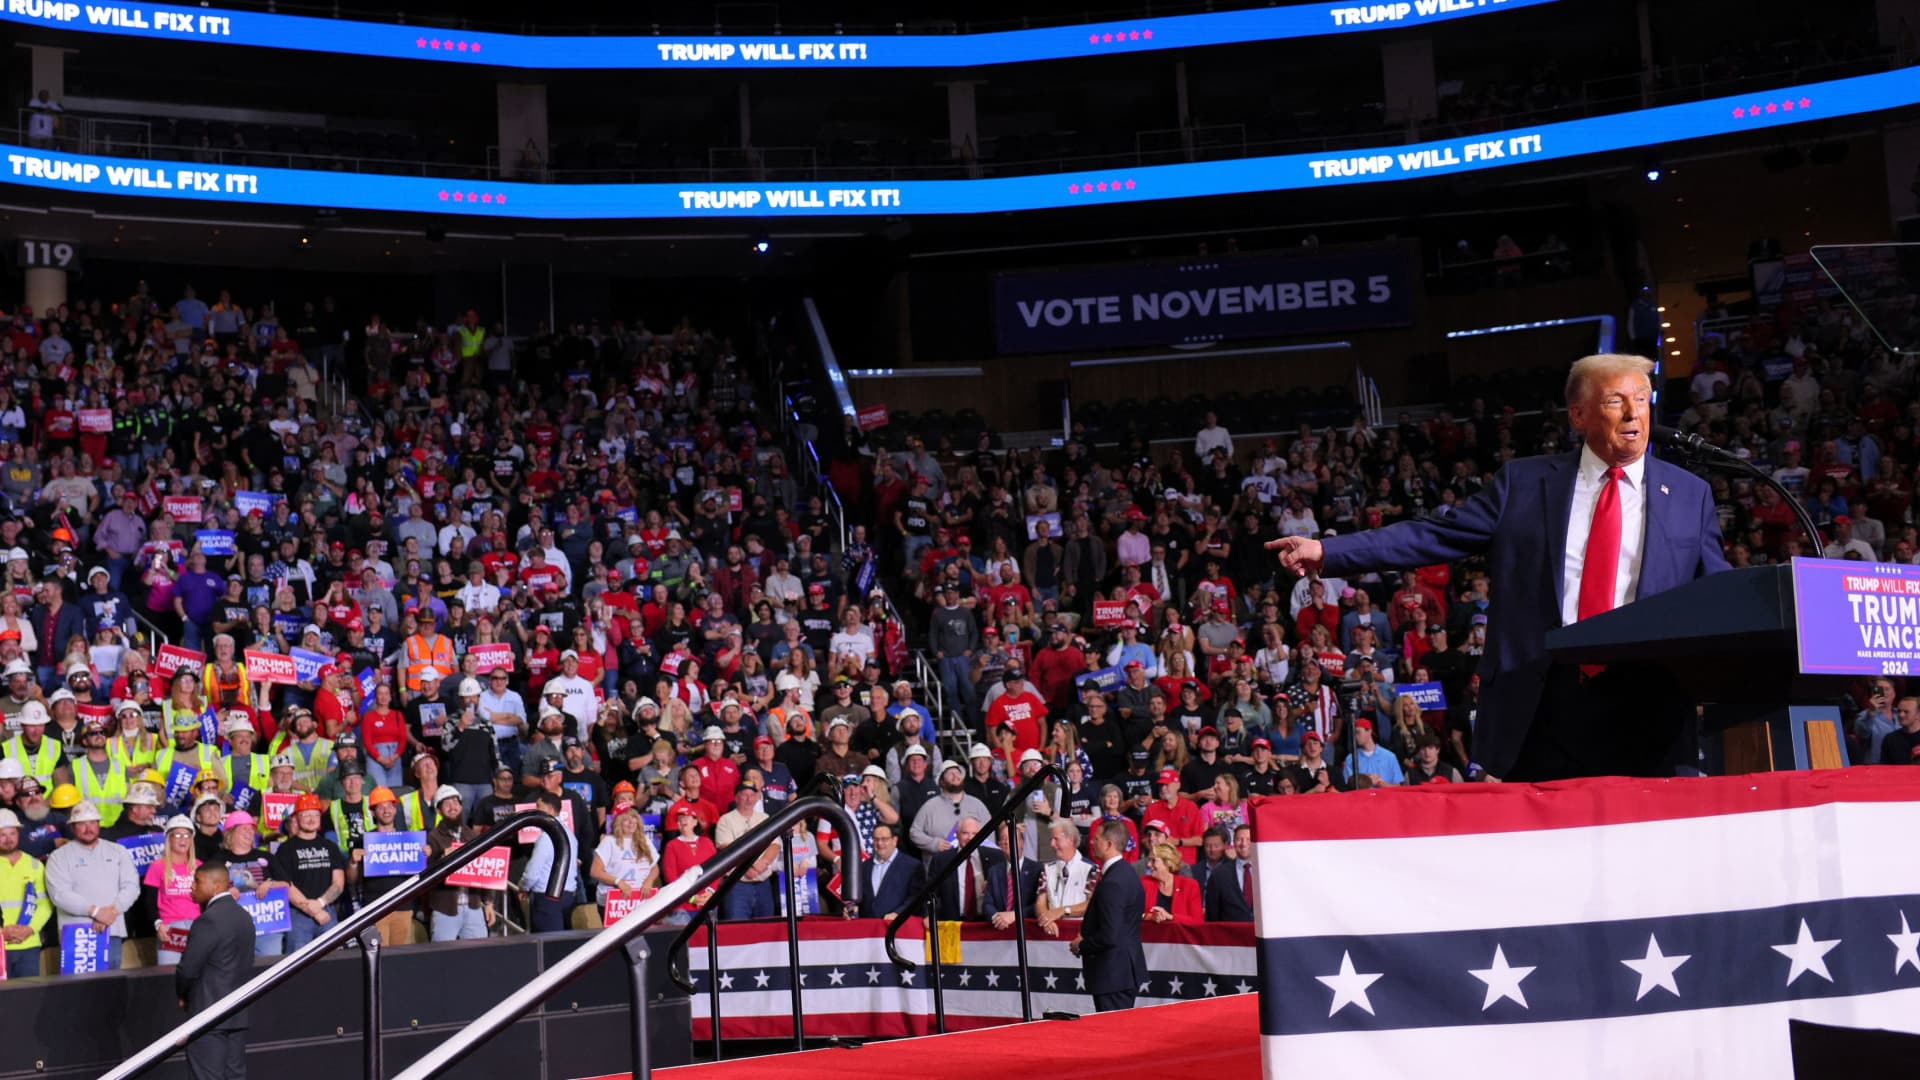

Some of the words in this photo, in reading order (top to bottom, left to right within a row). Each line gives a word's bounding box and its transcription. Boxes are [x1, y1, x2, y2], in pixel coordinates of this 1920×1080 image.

[0, 0, 81, 21] RUMP
[86, 5, 149, 29] WILL
[154, 12, 194, 33] FIX
[200, 16, 230, 36] IT!
[1331, 2, 1411, 25] TRUMP
[658, 43, 736, 61] TRUMP
[740, 43, 796, 61] WILL
[798, 43, 835, 60] FIX
[839, 43, 867, 60] IT!
[1309, 155, 1394, 179] TRUMP
[1397, 147, 1460, 171] WILL
[1464, 140, 1505, 162] FIX
[1510, 134, 1542, 156] IT!
[9, 155, 101, 184] TRUMP
[105, 166, 173, 190] WILL
[178, 171, 220, 192] FIX
[226, 174, 258, 194] IT!
[679, 190, 761, 209] TRUMP
[766, 190, 824, 208] WILL
[828, 190, 867, 208] FIX
[870, 189, 900, 208] IT!
[25, 242, 73, 267] 119
[1017, 296, 1121, 328] VOTE
[1132, 279, 1357, 321] NOVEMBER
[1368, 276, 1391, 304] 5
[1847, 577, 1880, 591] TRUMP
[1880, 579, 1905, 593] WILL
[1096, 608, 1124, 616] TRUM
[1848, 594, 1920, 625] TRUM
[161, 652, 202, 670] TRUMP
[249, 655, 292, 667] TRUMP
[1882, 660, 1909, 675] 2024
[126, 843, 165, 859] TRUM
[368, 842, 402, 852] DREAM
[369, 850, 419, 864] AGAIN!
[609, 899, 642, 911] TRU
[74, 927, 88, 975] RUMP
